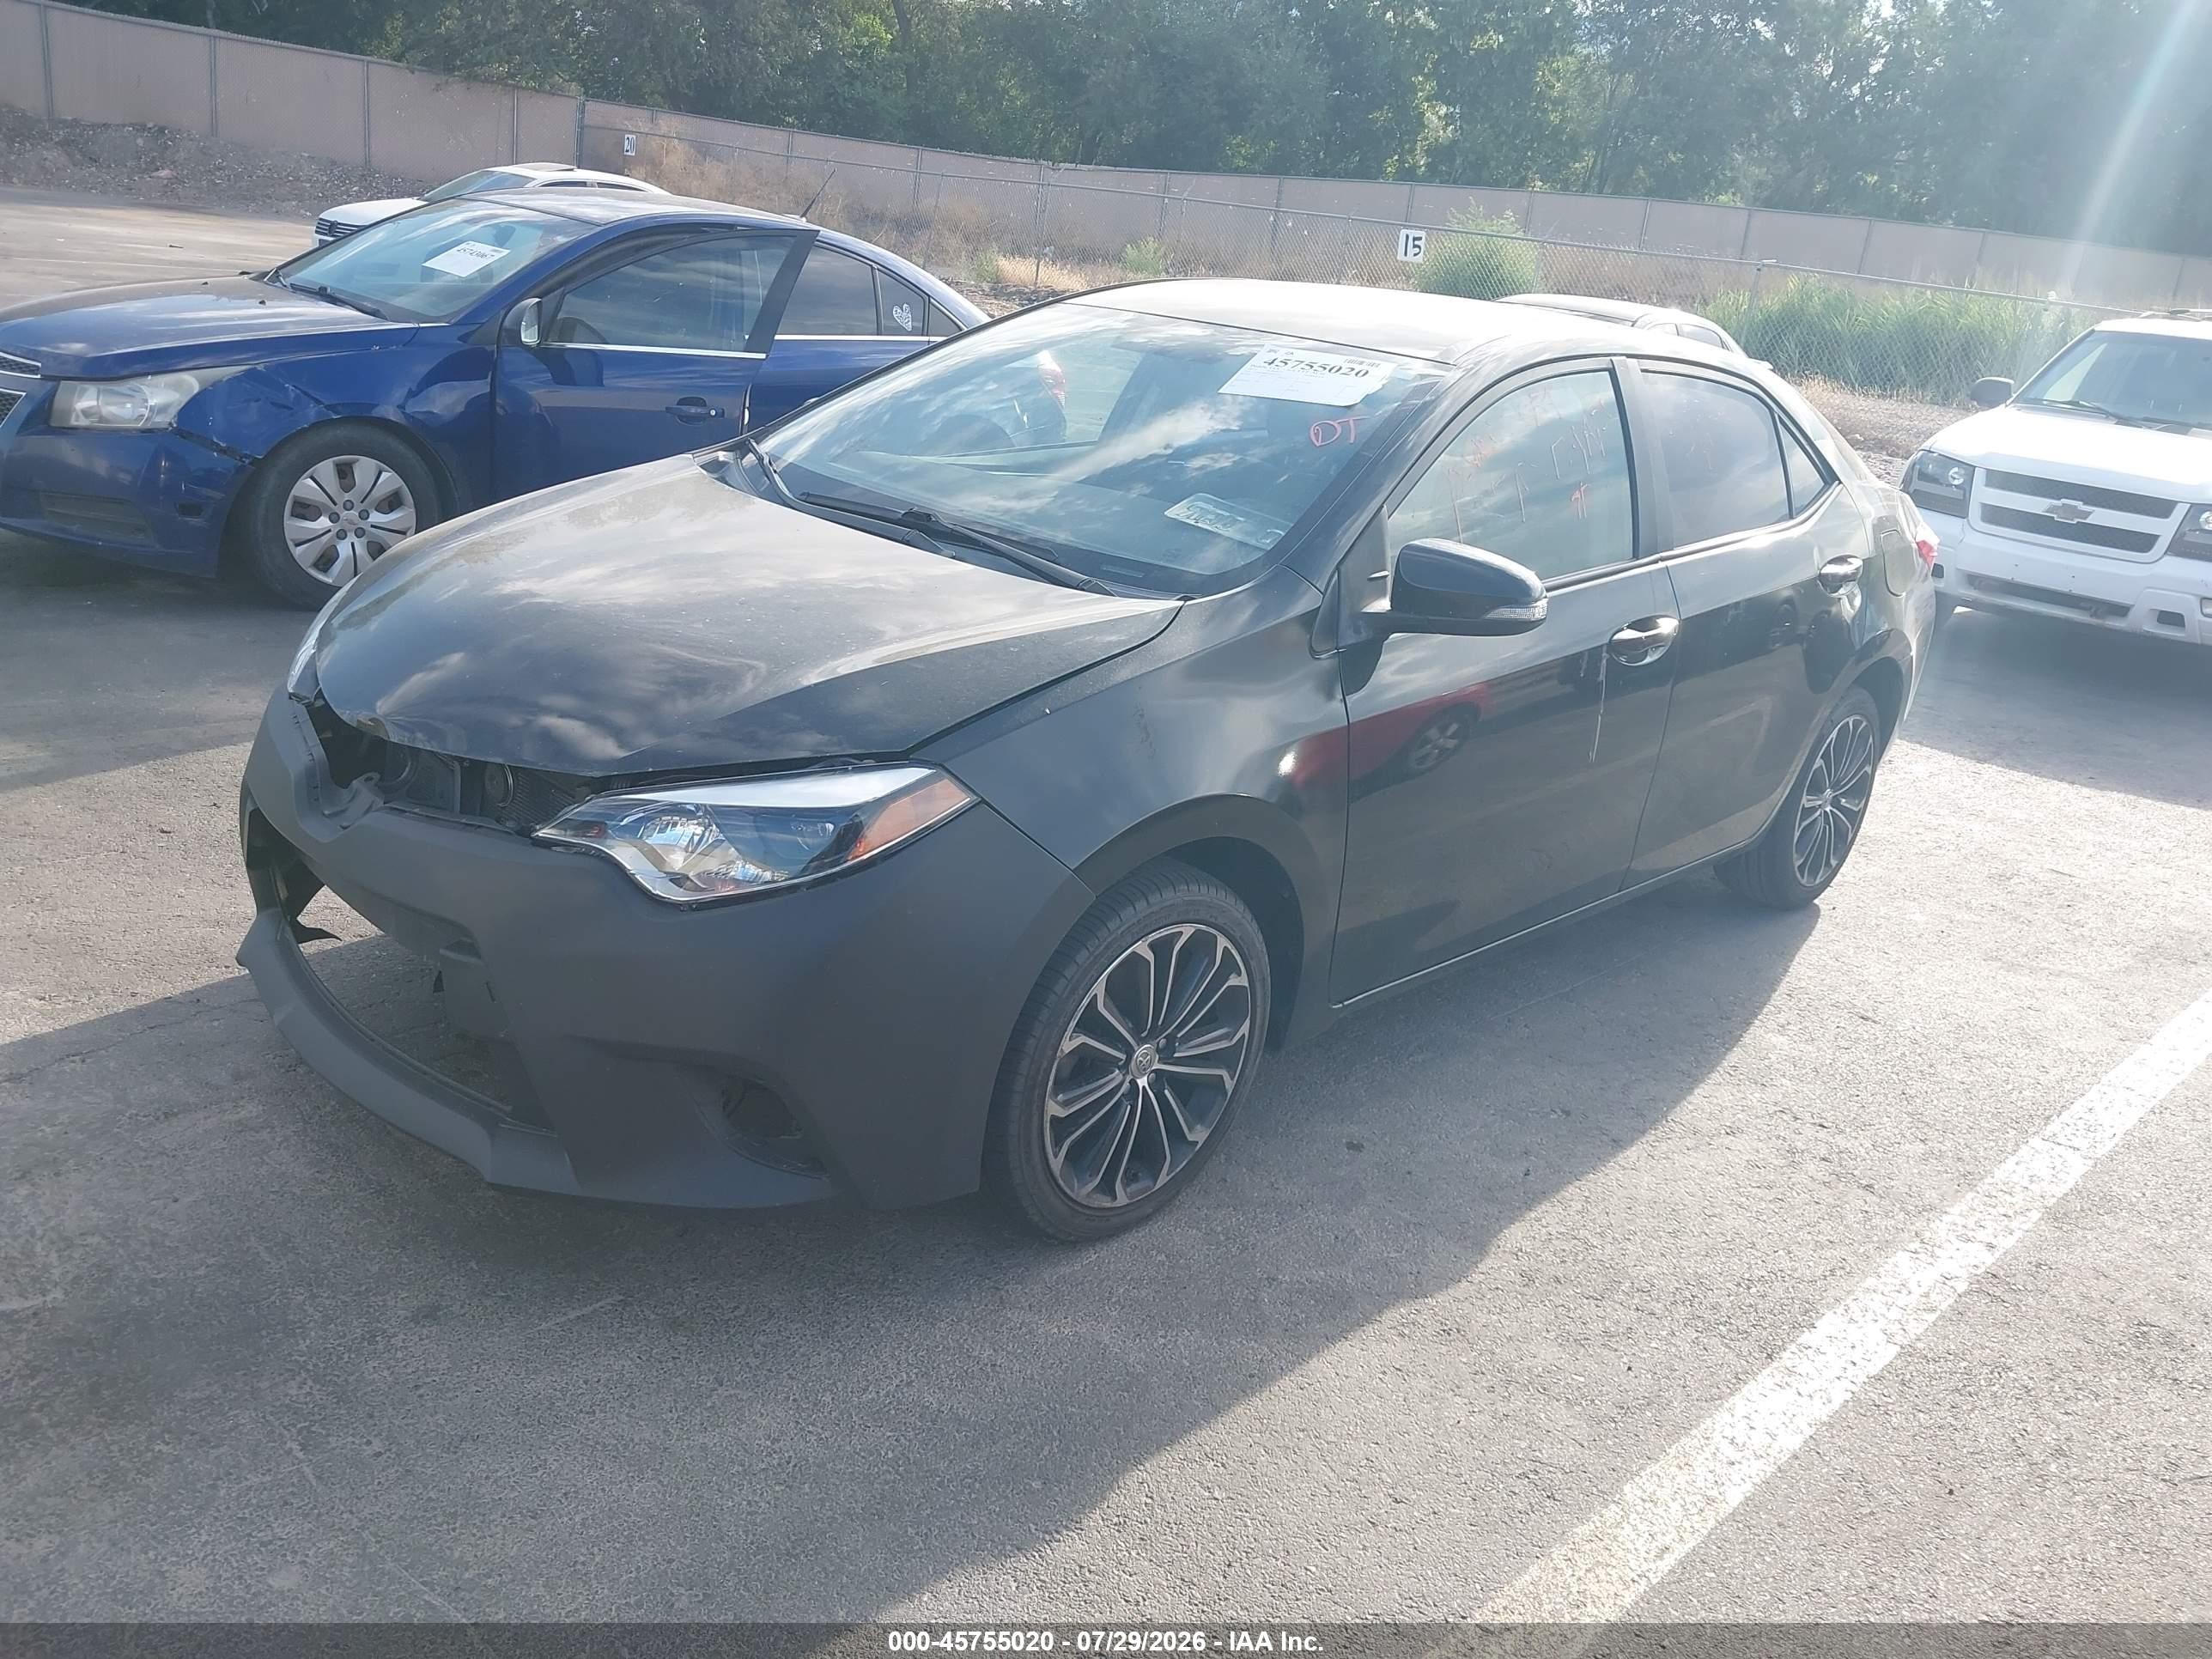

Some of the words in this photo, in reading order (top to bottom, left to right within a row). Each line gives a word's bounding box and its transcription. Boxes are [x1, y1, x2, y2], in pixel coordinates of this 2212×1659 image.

[624, 137, 635, 154] 20
[1403, 233, 1423, 257] 15
[1262, 356, 1370, 379] 45755020
[1310, 416, 1370, 447] DT
